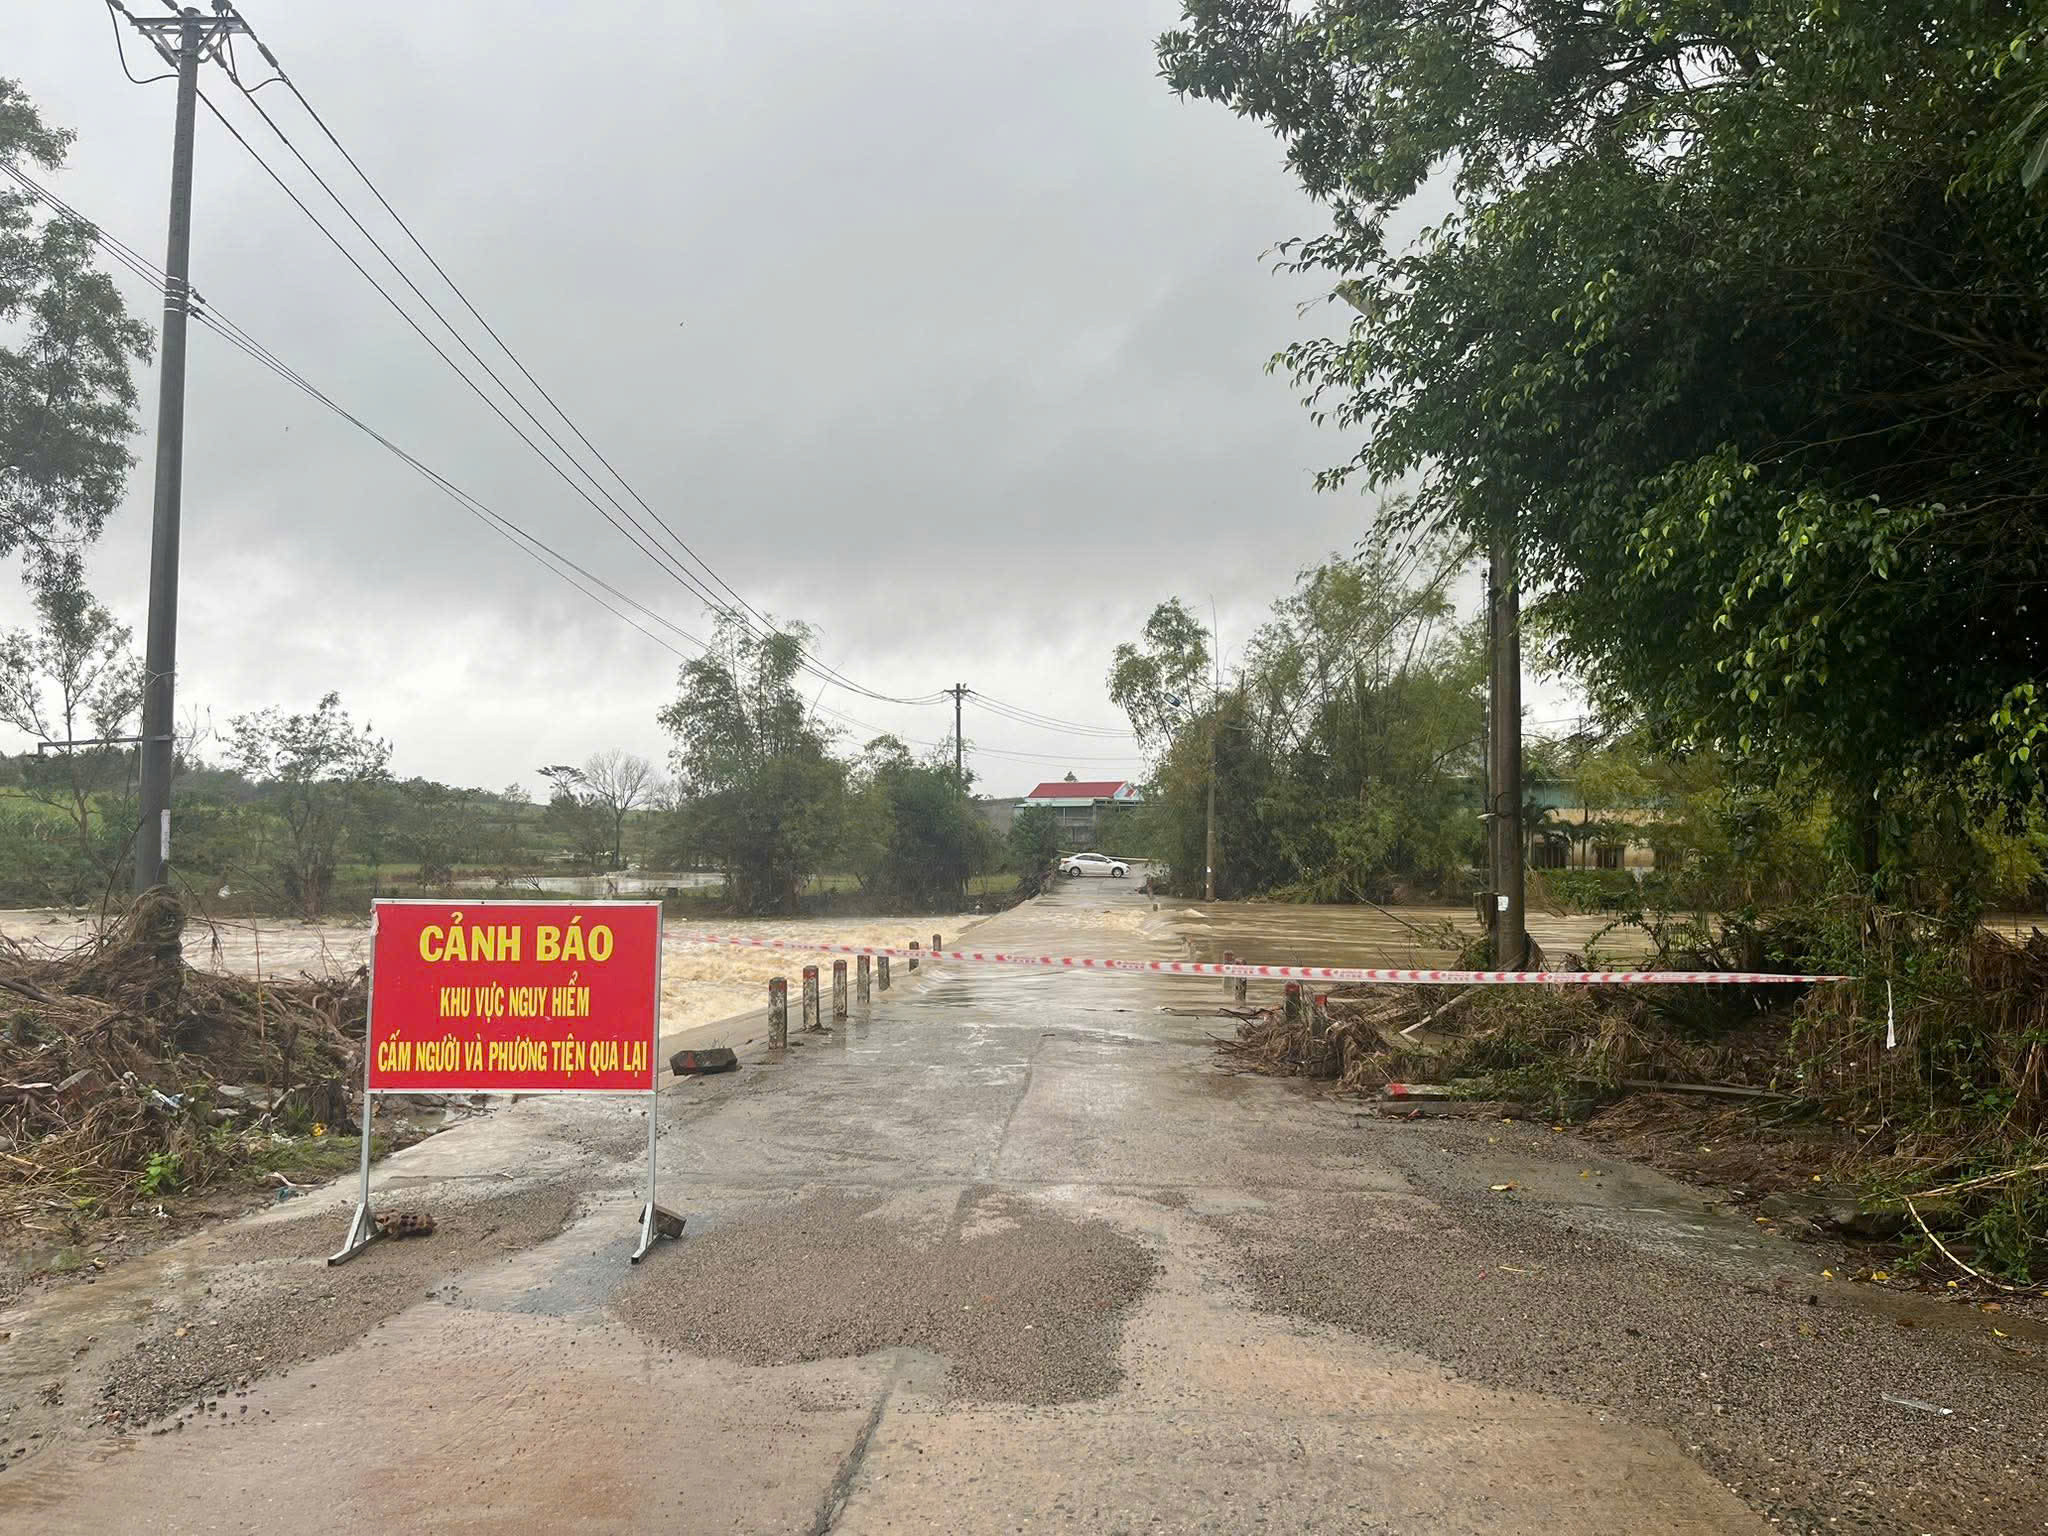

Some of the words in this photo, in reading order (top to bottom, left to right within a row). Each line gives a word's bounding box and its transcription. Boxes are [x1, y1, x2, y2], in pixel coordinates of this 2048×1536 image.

[419, 912, 521, 962] CẢNH
[536, 915, 614, 962] BÁO
[440, 986, 470, 1018] KHU
[475, 981, 505, 1023] VỰC
[508, 986, 548, 1018] NGUY
[551, 971, 590, 1018] HIỂM
[377, 1029, 411, 1072] CẤM
[415, 1033, 460, 1072] NGƯỜI
[464, 1033, 483, 1072] VÀ
[488, 1036, 547, 1072] PHƯƠNG
[551, 1034, 586, 1078] TIỆN
[589, 1040, 619, 1074] QUA
[623, 1040, 648, 1078] LẠI
